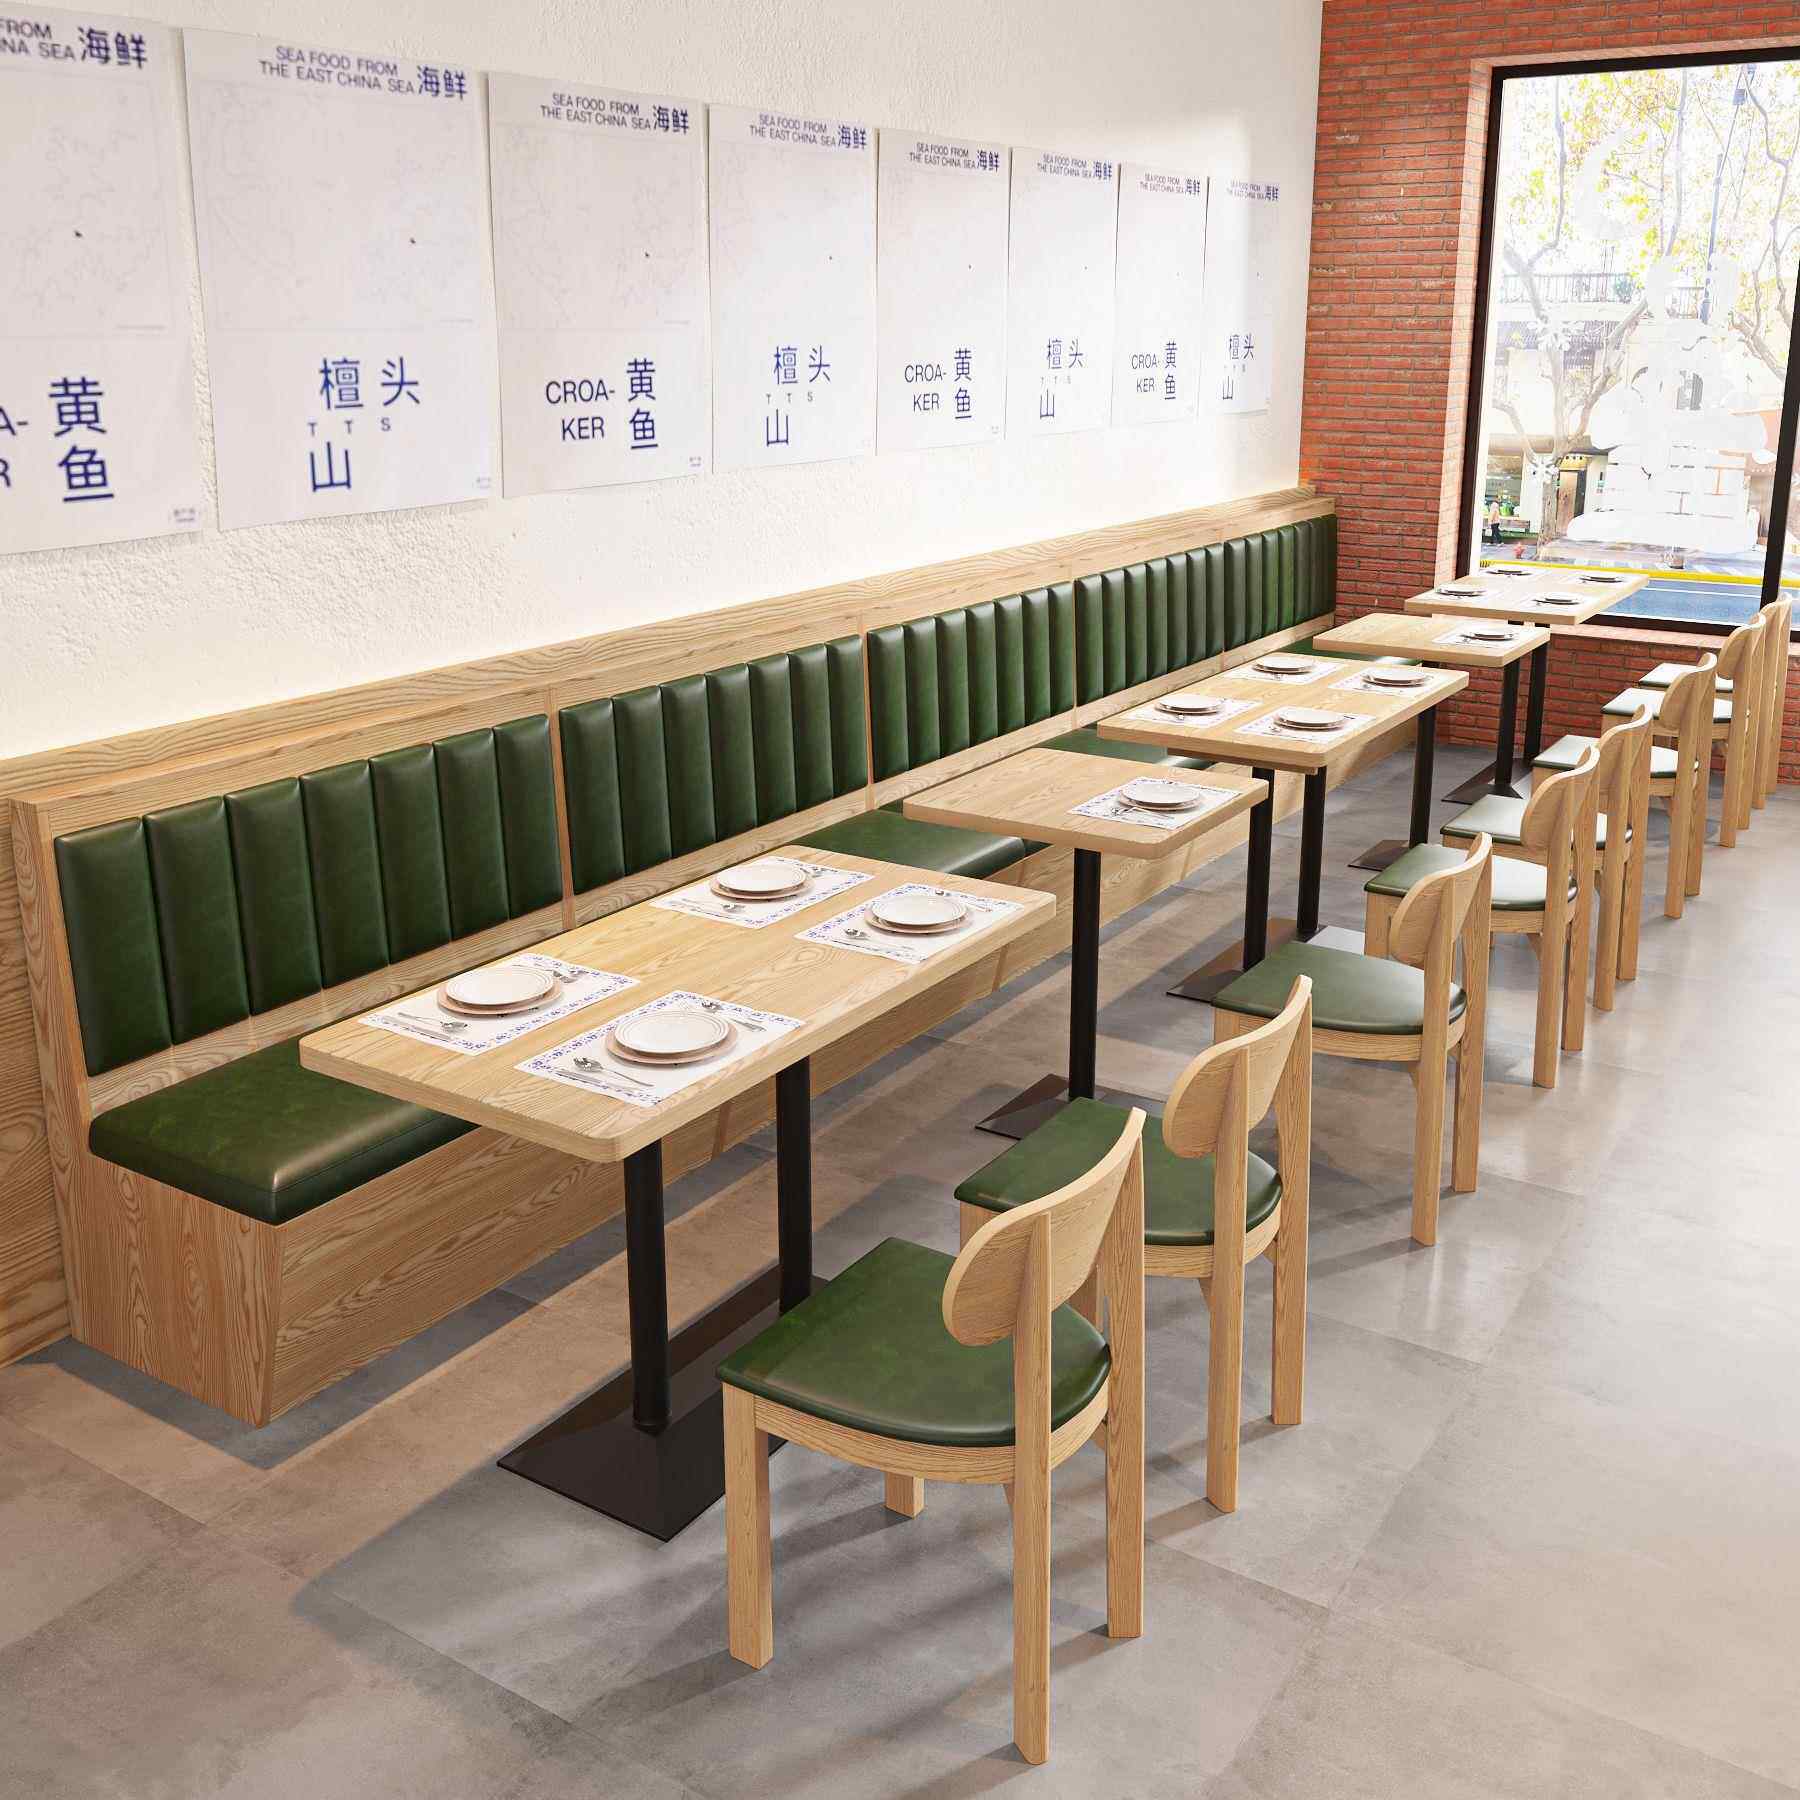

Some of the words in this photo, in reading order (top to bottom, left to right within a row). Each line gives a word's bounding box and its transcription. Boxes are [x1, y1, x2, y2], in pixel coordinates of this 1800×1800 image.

[39, 41, 76, 61] SEA
[77, 26, 148, 69] 海鲜
[276, 46, 305, 63] SEA
[310, 51, 350, 70] FOOD
[357, 58, 399, 76] FROM
[260, 60, 293, 78] THE
[297, 66, 333, 83] EAST
[337, 72, 381, 90] CHINA
[388, 79, 415, 94] SEA
[417, 64, 467, 100] 海鲜
[552, 92, 573, 107] SEA
[576, 96, 606, 111] FOOD
[610, 101, 640, 116] FROM
[541, 105, 562, 120] THE
[567, 109, 593, 123] EAST
[595, 112, 627, 128] CHINA
[632, 117, 651, 130] SEA
[653, 104, 689, 134] 海鲜
[759, 113, 775, 127] SEA
[777, 116, 800, 130] FOOD
[804, 120, 827, 133] FROM
[750, 124, 766, 138] THE
[770, 128, 790, 141] EAST
[792, 131, 817, 145] CHINA
[820, 135, 836, 147] SEA
[838, 124, 867, 150] 海鲜
[976, 149, 1000, 173] 海鲜
[904, 363, 947, 383] CROA-
[1131, 353, 1160, 369] CROA-
[1164, 340, 1177, 400] 黄鱼
[546, 379, 615, 404] CROA-
[954, 348, 972, 419] 黄鱼
[1137, 378, 1155, 393] KER
[626, 358, 659, 450] 黄鱼
[913, 393, 940, 413] KER
[1040, 388, 1055, 420] 山
[49, 376, 114, 502] 黄鱼
[308, 422, 317, 437] T
[344, 419, 353, 434] T
[381, 417, 391, 432] S
[561, 416, 605, 441] KER
[766, 408, 789, 447] 山
[310, 441, 351, 492] 山
